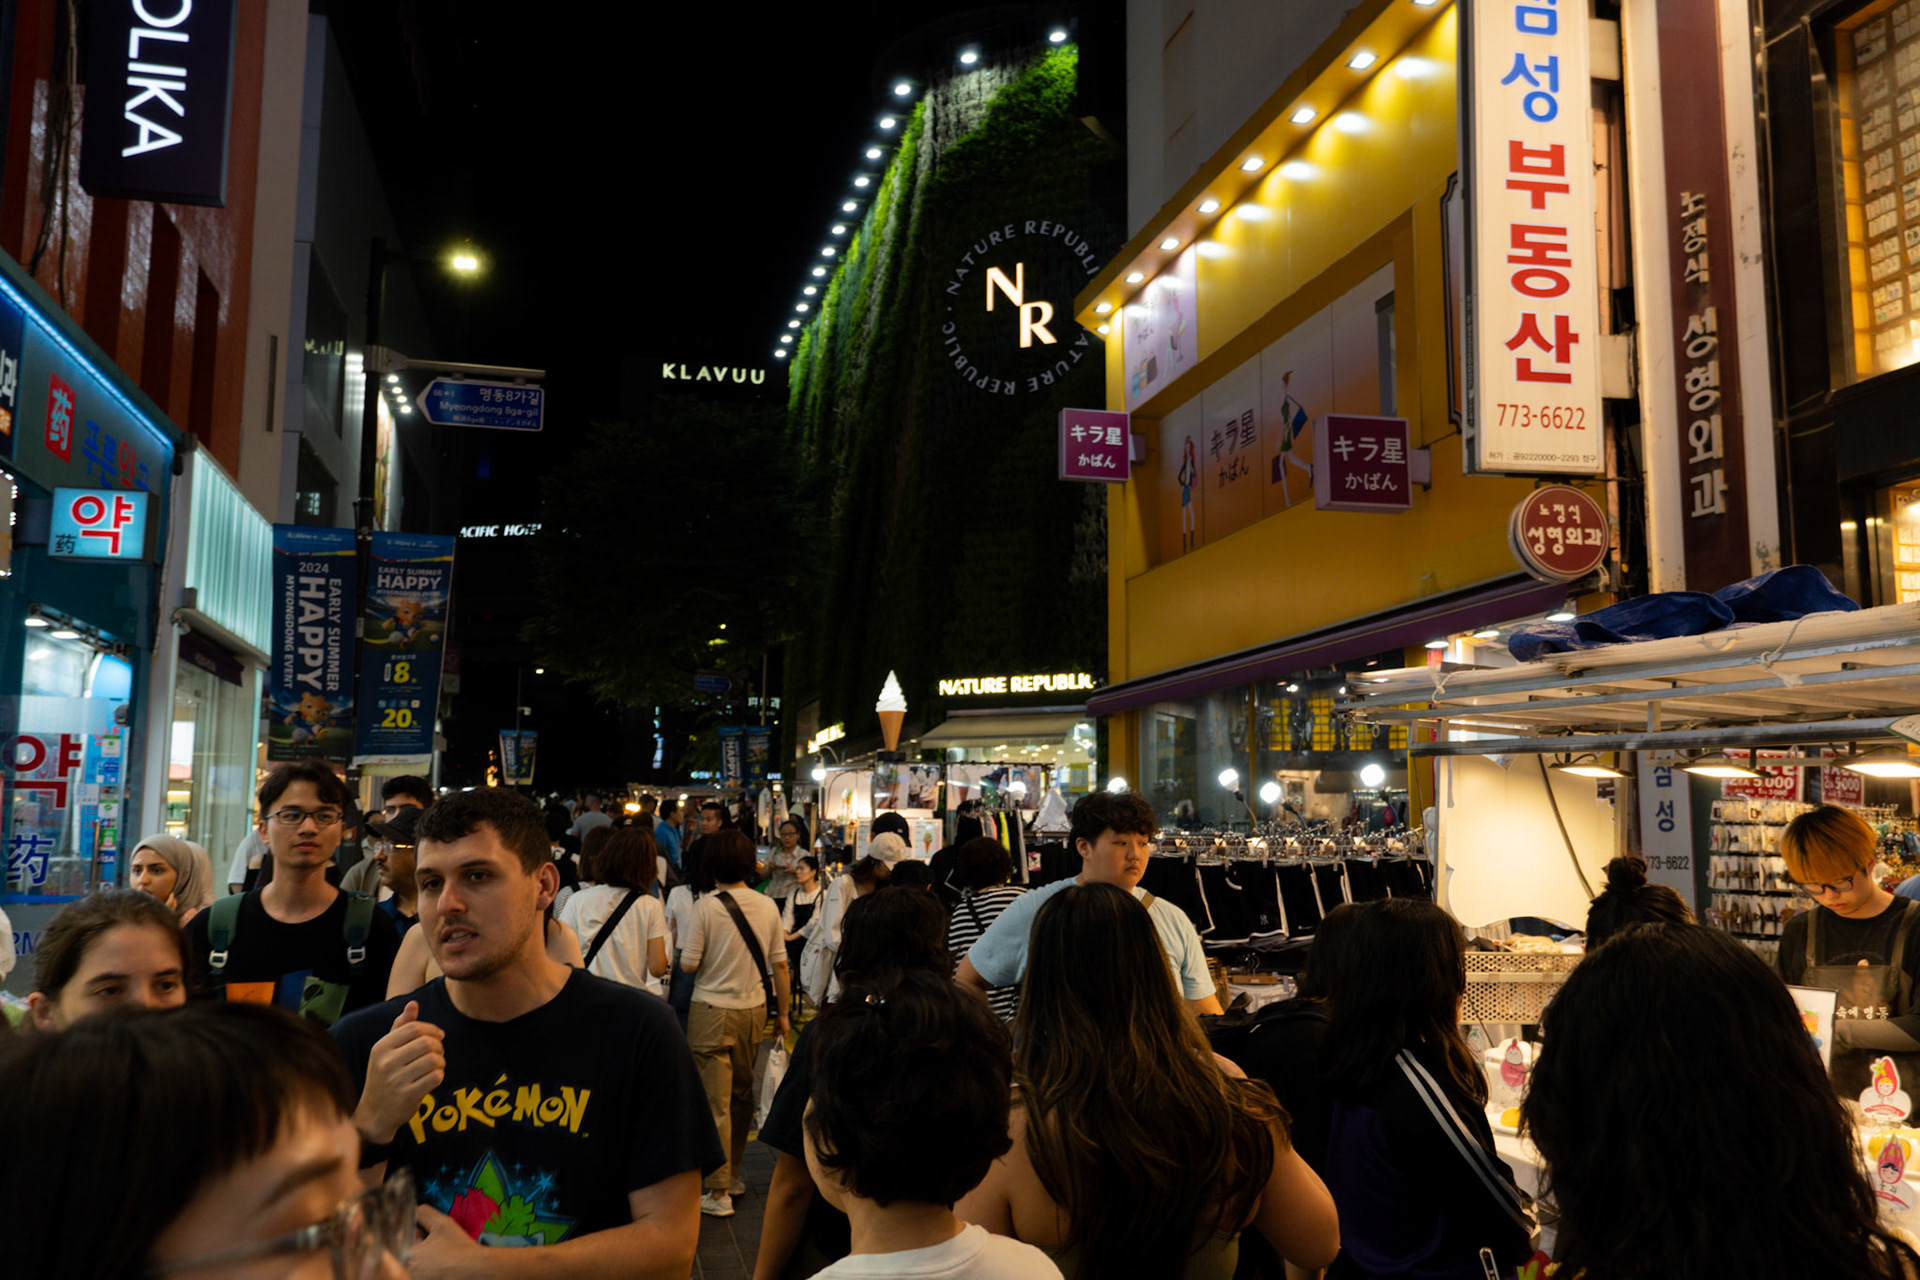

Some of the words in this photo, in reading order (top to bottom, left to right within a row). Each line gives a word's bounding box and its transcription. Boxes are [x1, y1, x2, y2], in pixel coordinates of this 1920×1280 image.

[1680, 191, 1710, 283] 노정식
[946, 223, 1017, 296] NATURE
[1024, 219, 1100, 282] REPUBLI
[662, 362, 766, 385] KLAVUU
[941, 321, 1016, 396] REPUBLIC
[439, 400, 503, 416] Myeongdong
[479, 387, 540, 406] 명동8가길
[1496, 403, 1587, 431] 773-6622
[1682, 306, 1728, 519] 성형외과
[1069, 424, 1124, 446] キラ星
[1209, 408, 1257, 463] キラ星
[1332, 435, 1406, 465] キラ星
[1077, 453, 1116, 469] かばん
[1218, 455, 1250, 490] かばん
[1344, 472, 1399, 491] かばん
[71, 494, 133, 554] 약
[1539, 503, 1582, 524] 노정식
[54, 533, 77, 554] 药
[1527, 526, 1602, 556] 성형외과
[299, 561, 329, 574] 2024
[377, 566, 405, 576] EARLY
[406, 568, 442, 577] SUMMER
[377, 574, 442, 590] HAPPY
[284, 574, 295, 651] MYEONGDONG
[327, 578, 342, 628] EARLY
[297, 575, 326, 691] HAPPY
[283, 655, 294, 689] EVENT
[326, 628, 341, 692] SUMMER
[939, 677, 1007, 695] NATURE
[2, 733, 82, 809] 약
[6, 834, 54, 884] 药
